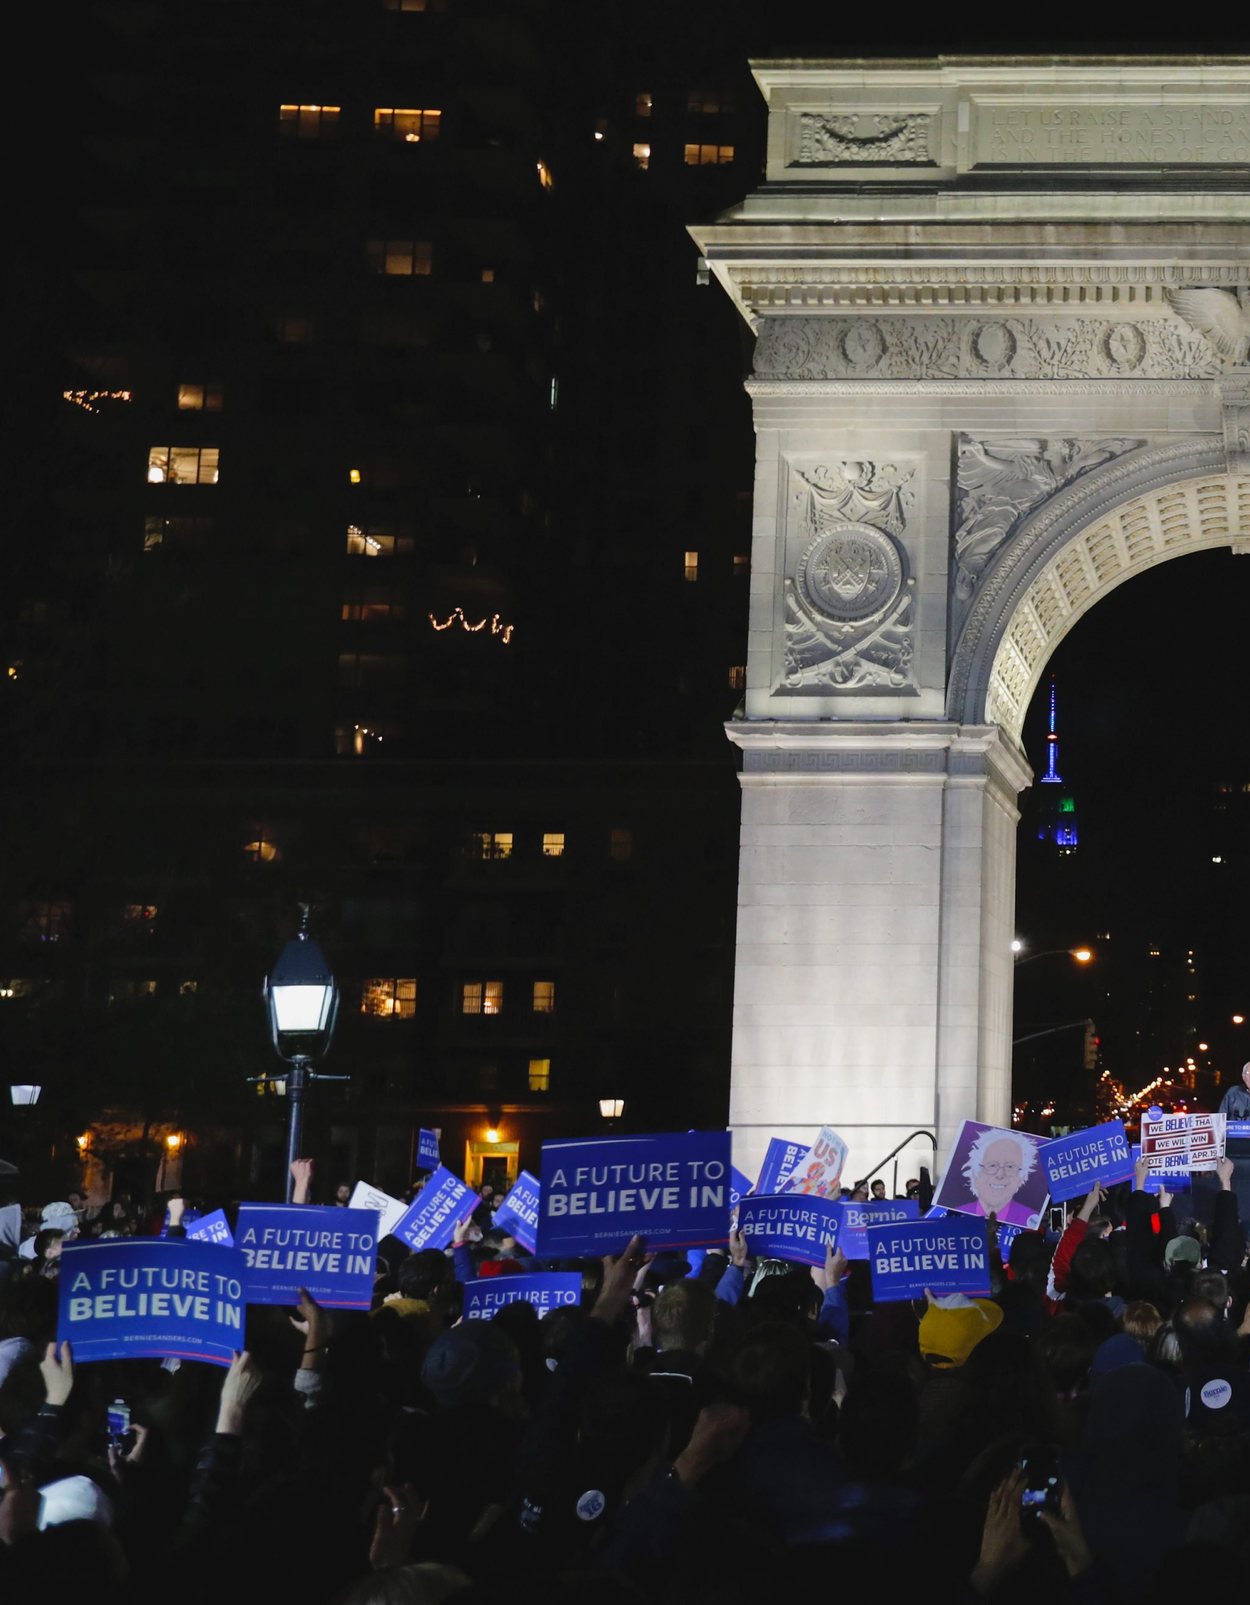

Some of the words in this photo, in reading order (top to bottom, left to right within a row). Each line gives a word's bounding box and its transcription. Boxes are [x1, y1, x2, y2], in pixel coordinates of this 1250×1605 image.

[991, 110, 1031, 126] LET
[1040, 110, 1065, 126] US
[1070, 110, 1132, 126] RAISE
[1141, 110, 1154, 126] A
[991, 128, 1034, 144] AND
[1045, 128, 1088, 144] THE
[1101, 128, 1191, 144] HONEST
[1050, 147, 1092, 162] THE
[1104, 147, 1167, 162] HAND
[1177, 147, 1209, 162] OF
[1150, 1123, 1163, 1133] WE
[1165, 1116, 1193, 1131] BELIEVE
[1195, 1118, 1212, 1126] THA
[1047, 1156, 1056, 1167] A
[1057, 1140, 1105, 1164] FUTURE
[1106, 1134, 1124, 1148] TO
[1157, 1140, 1170, 1148] WE
[1172, 1137, 1187, 1147] WIL
[1190, 1134, 1207, 1144] WIN
[420, 1147, 440, 1158] BELIE
[814, 1138, 838, 1167] US
[1148, 1157, 1163, 1166] OTE
[550, 1168, 568, 1188] A
[575, 1162, 680, 1187] FUTURE
[687, 1161, 725, 1180] TO
[773, 1145, 798, 1194] BELIEV
[1049, 1152, 1109, 1182] BELIEVE
[1111, 1147, 1128, 1162] IN
[514, 1185, 523, 1196] A
[522, 1188, 540, 1208] FUT
[547, 1187, 680, 1217] BELIEVE
[690, 1185, 724, 1208] IN
[404, 1230, 413, 1241] A
[411, 1190, 446, 1232] FUTURE
[441, 1177, 457, 1192] TO
[412, 1197, 456, 1248] BELIEVE
[451, 1183, 467, 1200] IN
[846, 1208, 907, 1226] Bernie
[208, 1220, 225, 1233] TO
[744, 1210, 754, 1221] A
[758, 1208, 817, 1225] FUTURE
[821, 1215, 838, 1231] TO
[212, 1229, 228, 1243] IN
[243, 1228, 257, 1244] A
[263, 1228, 343, 1249] FUTURE
[345, 1233, 374, 1251] TO
[594, 1228, 672, 1238] BERNIESANDERS.COM
[742, 1222, 816, 1241] BELIEVE
[819, 1232, 836, 1248] IN
[875, 1242, 887, 1255] A
[891, 1236, 956, 1254] FUTURE
[960, 1236, 983, 1250] TO
[346, 1255, 371, 1275] IN
[876, 1253, 959, 1274] BELIEVE
[964, 1253, 985, 1269] IN
[71, 1272, 92, 1292] A
[101, 1268, 210, 1292] FUTURE
[215, 1275, 242, 1299] TO
[470, 1296, 481, 1307] A
[553, 1290, 577, 1304] TO
[69, 1293, 210, 1321] BELIEVE
[216, 1301, 241, 1329] IN
[123, 1334, 203, 1344] BERNIESANDERS.COM
